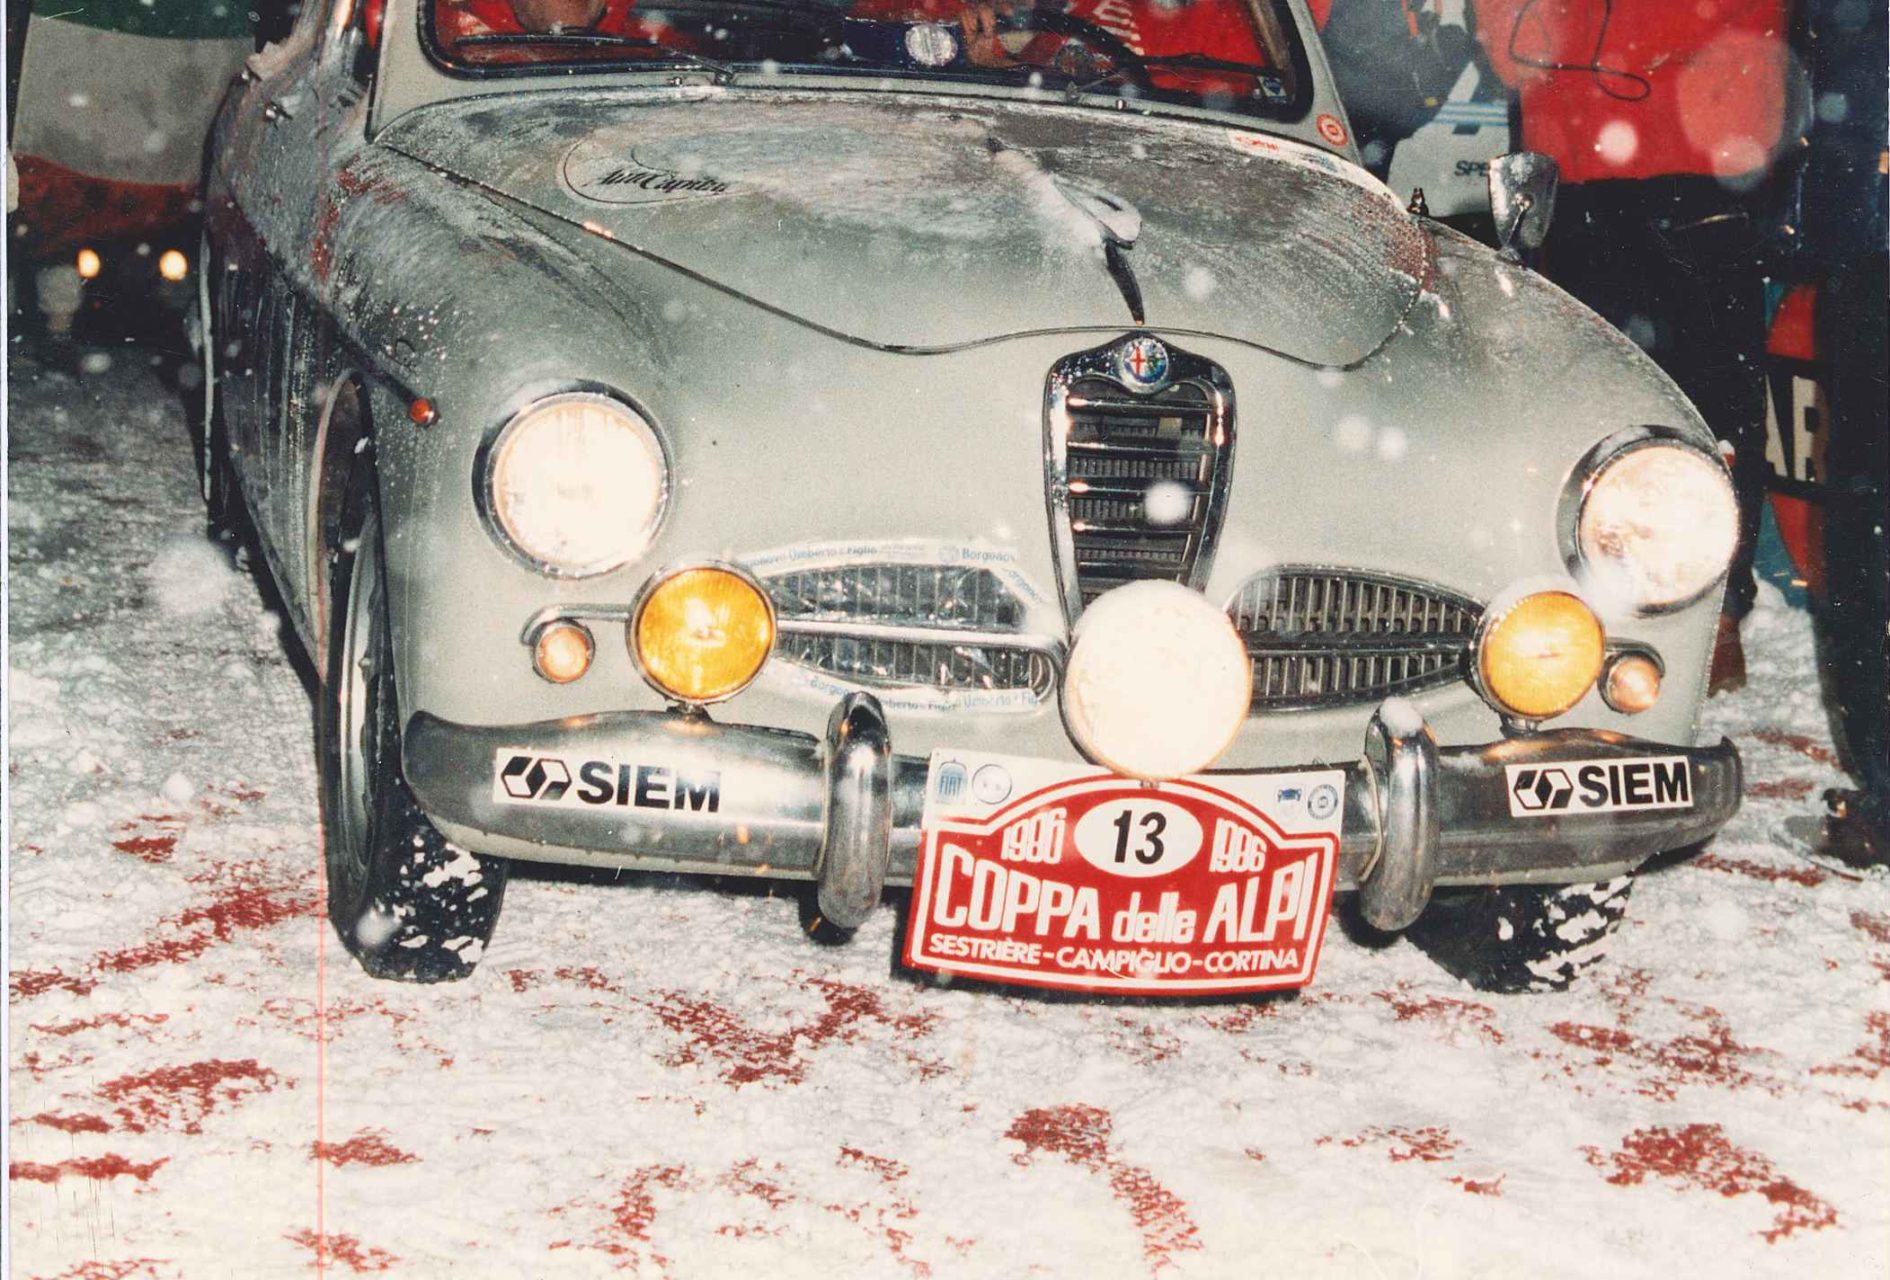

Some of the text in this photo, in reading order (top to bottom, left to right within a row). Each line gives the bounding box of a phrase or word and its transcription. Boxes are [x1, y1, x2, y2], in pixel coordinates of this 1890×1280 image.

[576, 760, 721, 813] SIEM
[1577, 761, 1690, 808] SIEM
[1112, 809, 1168, 865] 13
[933, 842, 1319, 944] COPPA delle ALPI
